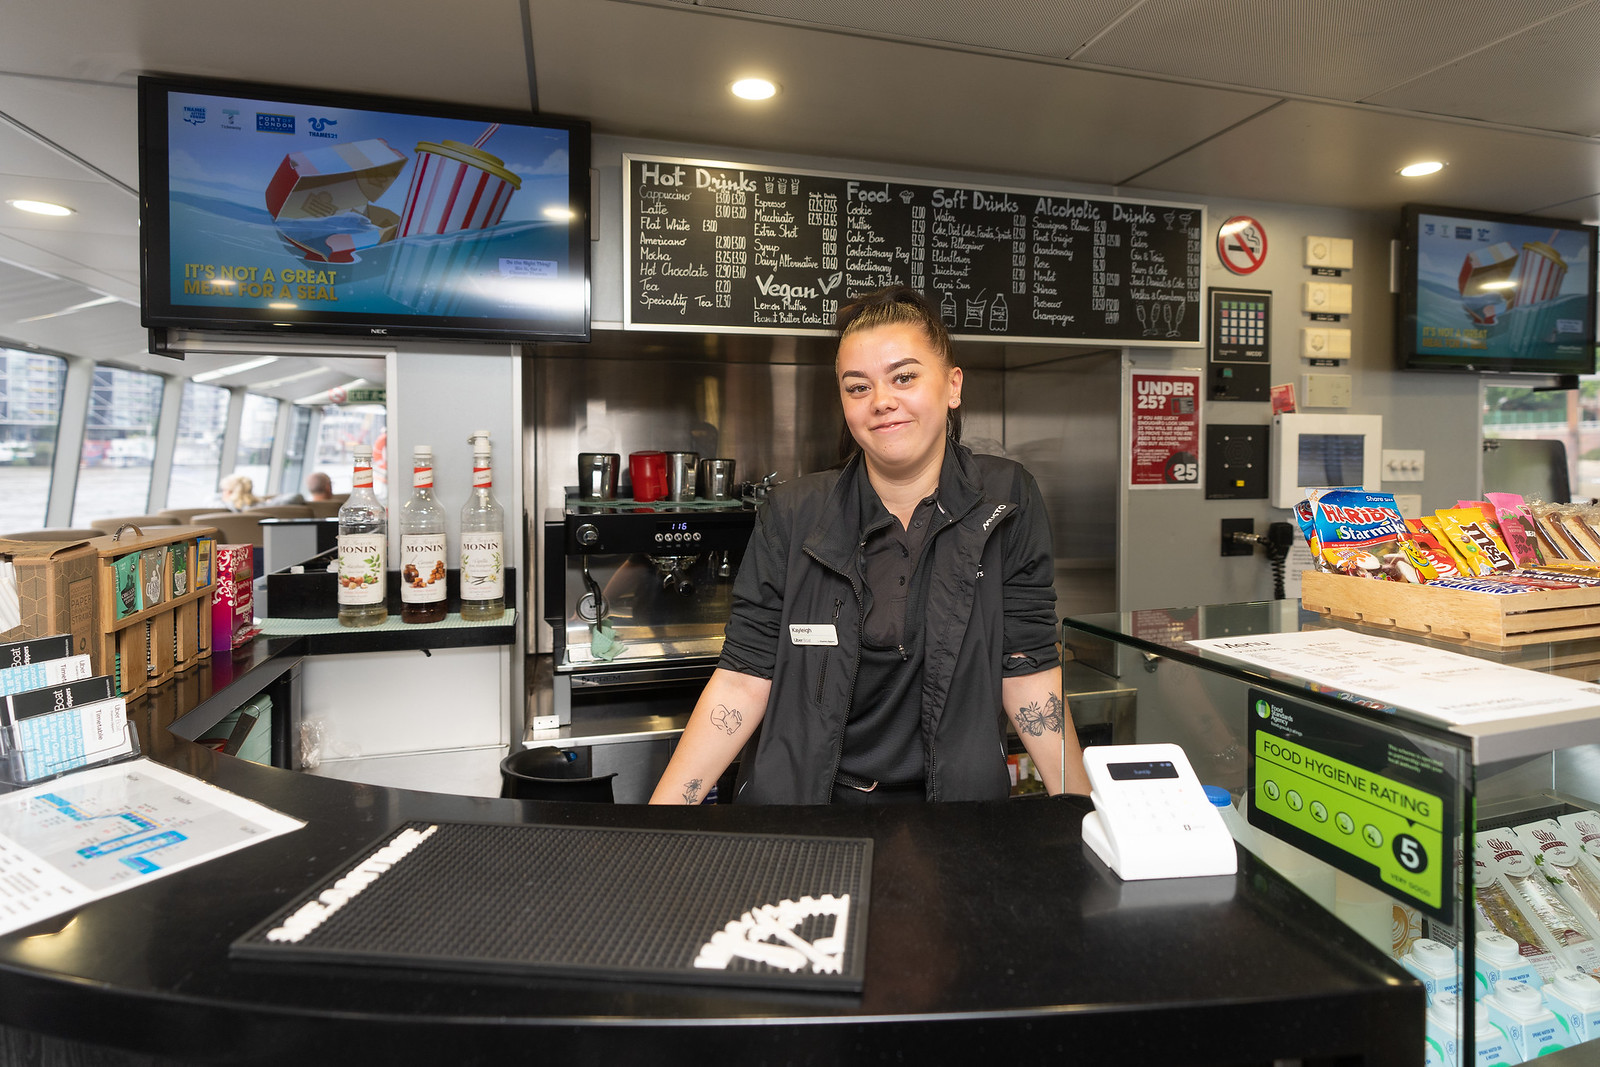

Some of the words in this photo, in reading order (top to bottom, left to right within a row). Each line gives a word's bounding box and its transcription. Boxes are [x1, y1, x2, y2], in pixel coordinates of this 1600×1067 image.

[642, 163, 686, 186] Hot
[696, 168, 757, 192] Drinks
[639, 185, 692, 203] Cappuccino
[847, 182, 892, 203] Food
[640, 200, 669, 214] Latte
[755, 194, 786, 212] Espresso
[846, 201, 872, 215] Cookie
[932, 189, 968, 209] Soft
[973, 191, 1019, 212] Drinks
[755, 209, 795, 223] Macchiato
[934, 208, 956, 222] Water
[1035, 197, 1100, 220] Alcoholic
[1113, 204, 1156, 224] Drinks
[640, 216, 661, 230] Flat
[666, 218, 690, 231] White
[754, 223, 776, 236] Extra
[779, 224, 799, 238] Shot
[847, 216, 871, 230] Muffin
[1032, 216, 1068, 232] Sauvignon
[1070, 219, 1090, 232] Blanc
[640, 232, 687, 246] Americano
[846, 230, 865, 243] Cake
[867, 231, 885, 243] Bar
[1033, 229, 1049, 241] Pinot
[1051, 232, 1073, 248] Grigio
[754, 238, 780, 257] Syrup
[932, 235, 948, 248] San
[951, 236, 984, 254] Pellegrino
[1033, 243, 1073, 261] Chardonnay
[640, 246, 672, 261] Mocha
[896, 247, 910, 264] Bag
[932, 250, 971, 264] Elderflower
[1130, 248, 1142, 261] Gin
[1149, 250, 1164, 263] Tonic
[640, 262, 657, 275] Hot
[662, 263, 709, 277] Chocolate
[755, 253, 778, 272] Dairy
[779, 254, 819, 268] Alternative
[932, 264, 971, 276] Juiceburst
[1131, 262, 1146, 274] Rum
[185, 264, 215, 279] IT'S
[221, 265, 258, 281] NOT
[263, 268, 276, 282] A
[281, 269, 337, 285] GREAT
[1033, 270, 1056, 282] Merlot
[184, 280, 233, 296] MEAL
[238, 282, 274, 298] FOR
[279, 285, 292, 299] A
[297, 285, 338, 301] SEAL
[640, 277, 660, 291] Tea
[755, 274, 819, 302] Vegan
[932, 277, 954, 292] Capri
[956, 278, 970, 289] Sun
[1032, 283, 1058, 295] Shiraz
[640, 292, 688, 315] Speciality
[695, 295, 713, 307] Tea
[754, 297, 780, 310] Lemon
[783, 300, 807, 311] Muffin
[1033, 295, 1062, 308] Prosecco
[754, 311, 778, 322] Peanut
[779, 312, 800, 323] Butter
[802, 313, 821, 324] Cookie
[1032, 309, 1075, 327] Champagne
[1137, 381, 1194, 396] UNDER
[1138, 395, 1166, 409] 25?
[1173, 463, 1197, 481] 25
[1320, 502, 1400, 525] HARIBO
[671, 522, 688, 530] 116
[340, 545, 376, 553] MONIN
[464, 542, 498, 550] MONIN
[53, 689, 65, 711] Boat
[1271, 704, 1283, 713] Food
[1271, 710, 1293, 722] Standards
[95, 709, 103, 741] Timetable
[1271, 716, 1288, 726] Agency
[1263, 740, 1302, 765] FOOD
[1305, 756, 1366, 792] HYGIENE
[1370, 781, 1430, 818] RATING
[1531, 829, 1557, 844] Soho
[1487, 838, 1513, 853] Soho
[1399, 837, 1420, 870] 5
[1390, 872, 1407, 886] VERY
[1409, 880, 1431, 898] GOOD
